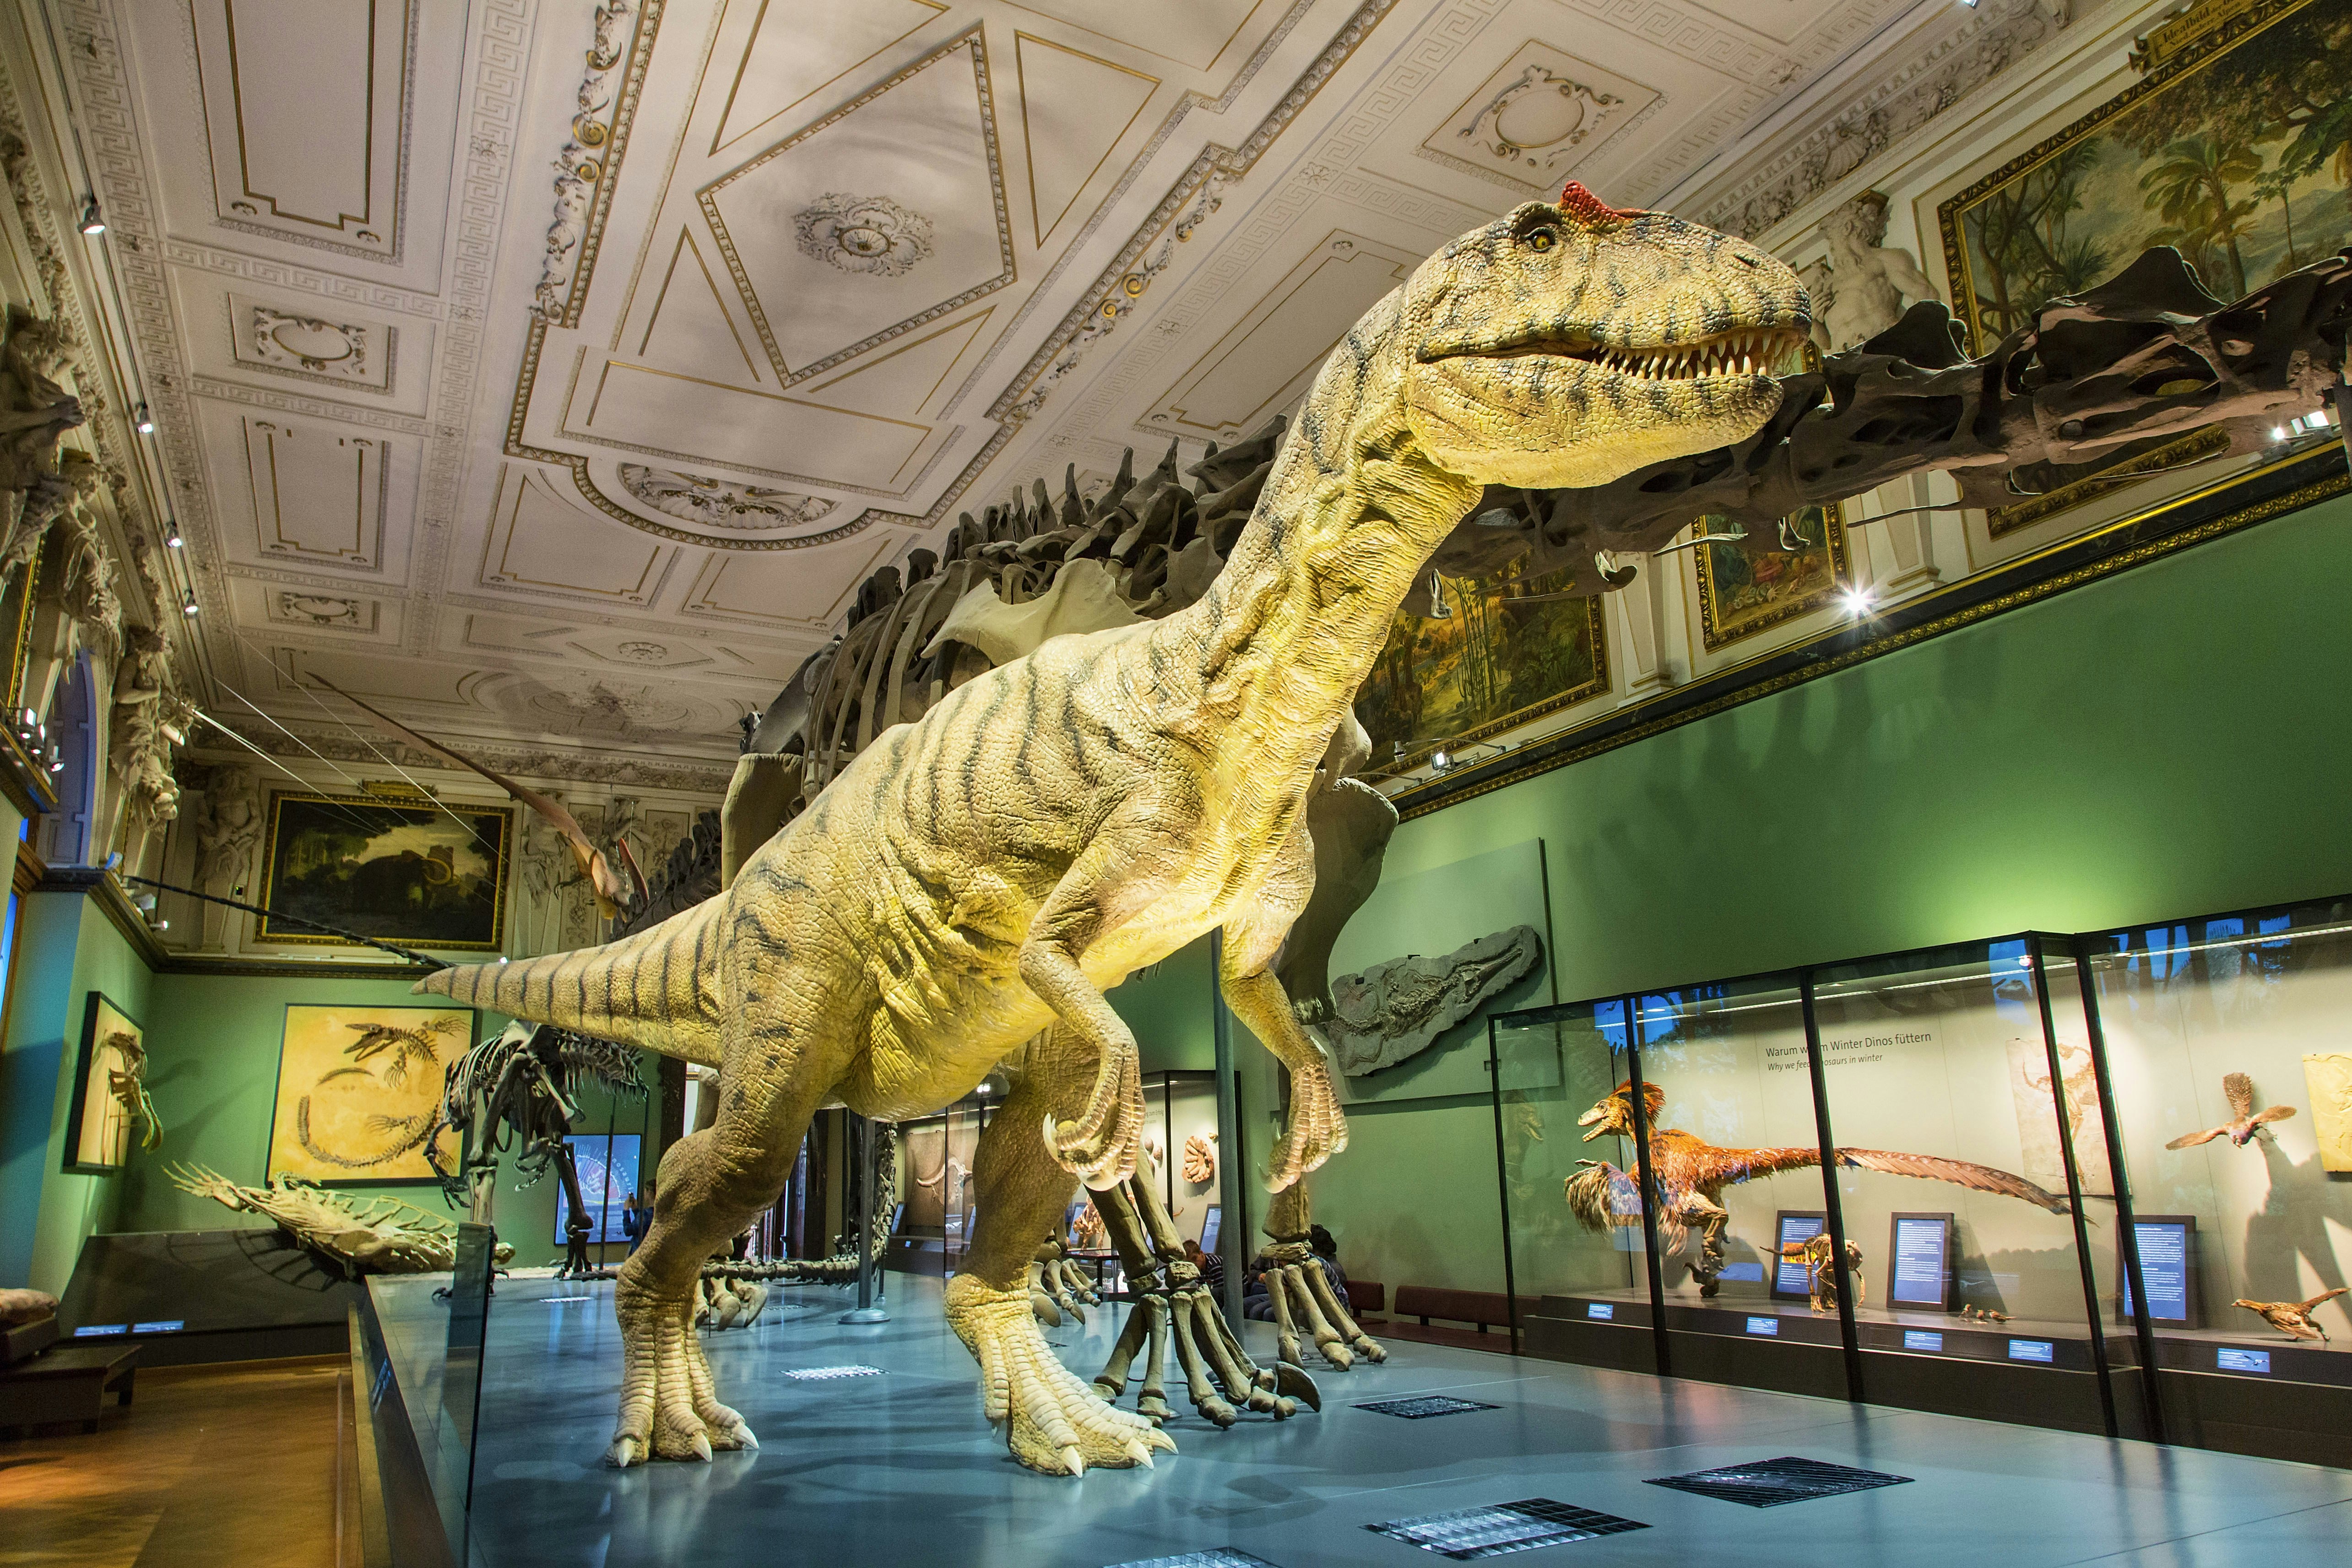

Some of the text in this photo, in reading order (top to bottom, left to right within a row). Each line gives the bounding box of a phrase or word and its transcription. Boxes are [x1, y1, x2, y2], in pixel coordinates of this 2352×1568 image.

[2163, 7, 2210, 42] Idealbild
[1766, 1047, 1798, 1057] Warum
[1830, 1040, 1862, 1051] Winter
[1865, 1036, 1893, 1047] Dinos
[1895, 1033, 1931, 1044] füttern
[1768, 1062, 1783, 1072] Why
[1824, 1057, 1847, 1066] osaurs
[1858, 1054, 1882, 1063] winter
